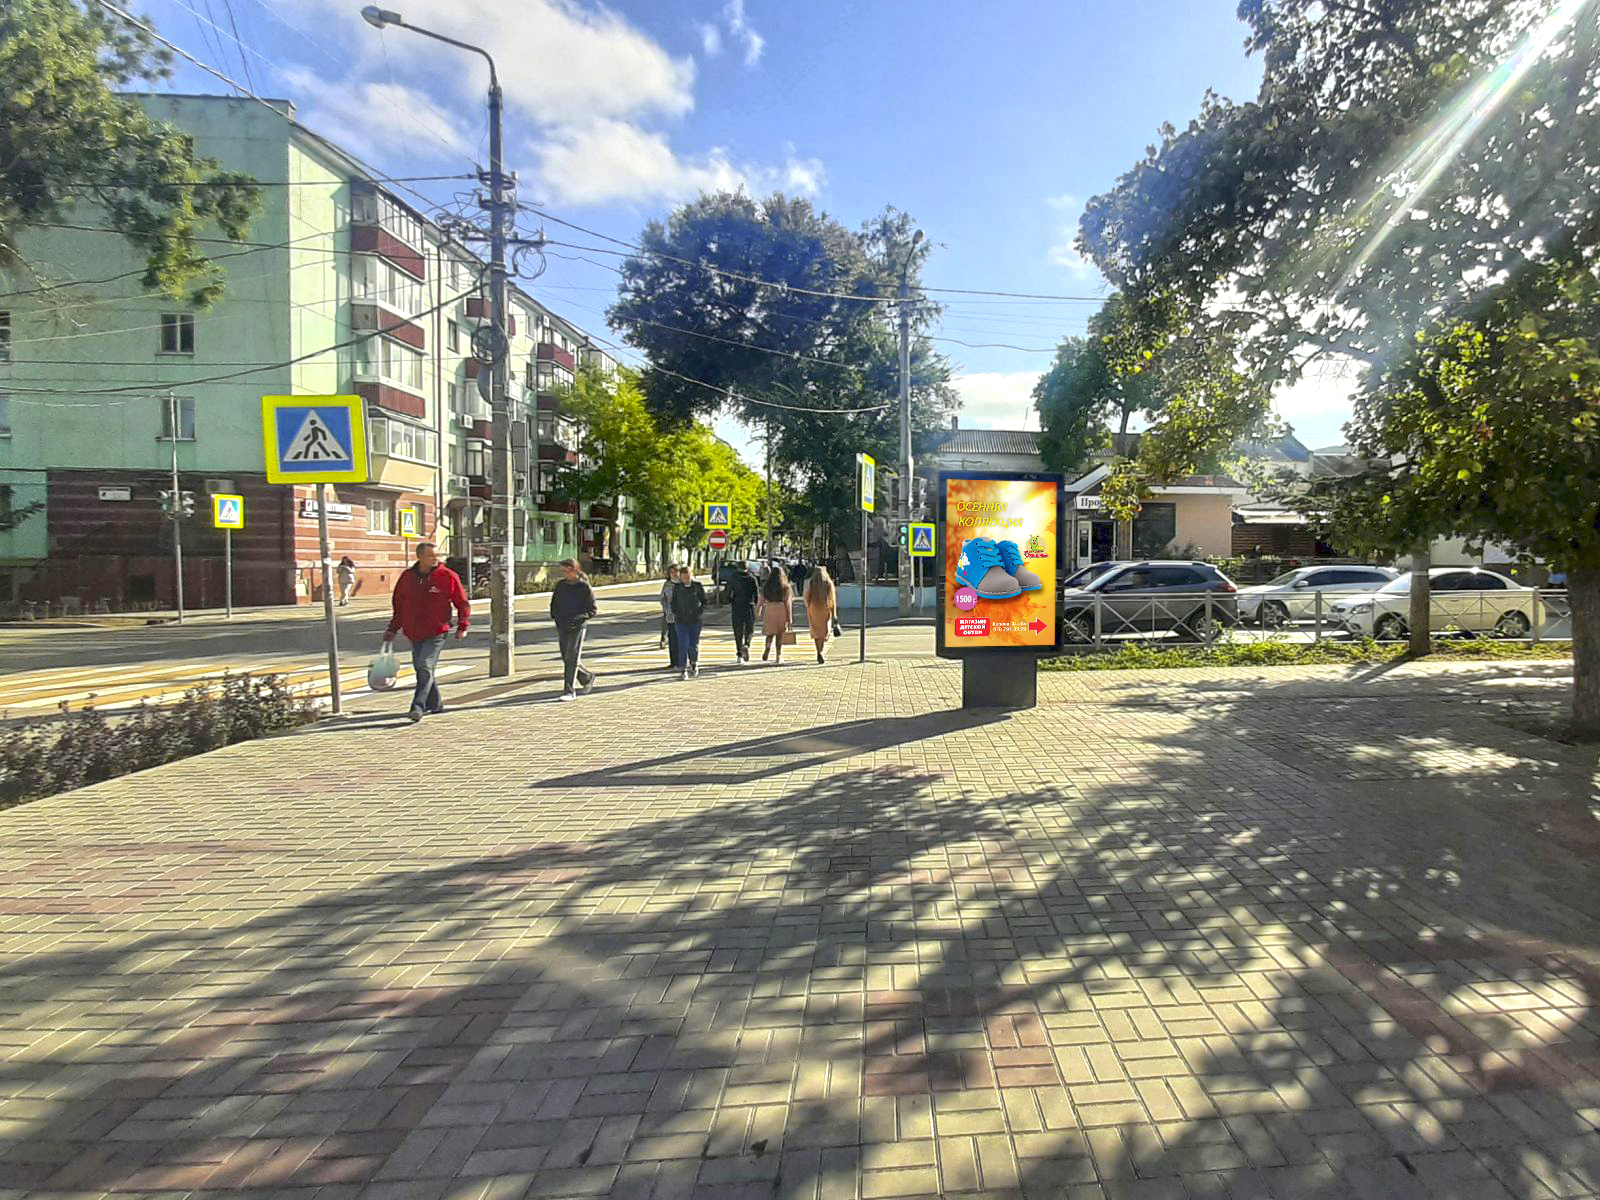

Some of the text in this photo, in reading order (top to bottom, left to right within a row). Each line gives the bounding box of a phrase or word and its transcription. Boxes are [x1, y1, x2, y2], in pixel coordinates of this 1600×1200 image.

[956, 501, 1008, 512] ОСЕННЯЯ
[1080, 497, 1103, 509] Про
[958, 516, 1024, 529] КОЛЛЕКЦИЯ
[956, 595, 972, 603] 1500
